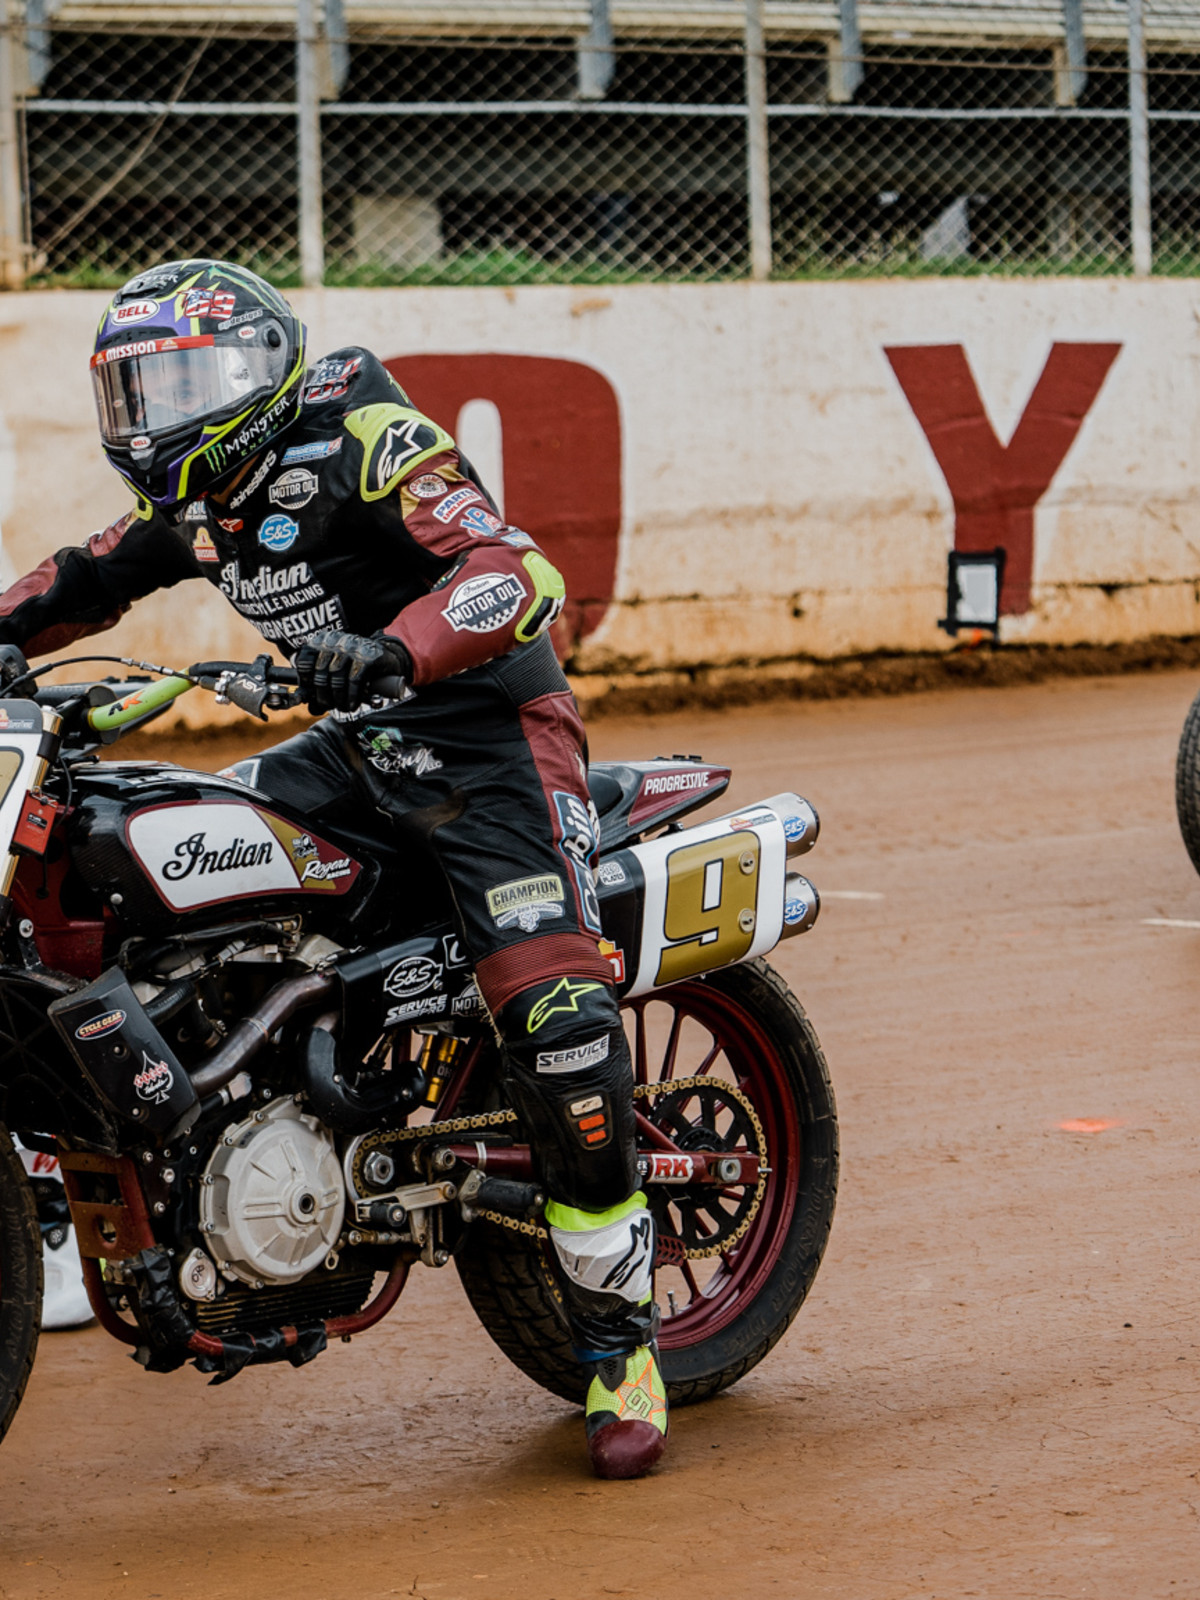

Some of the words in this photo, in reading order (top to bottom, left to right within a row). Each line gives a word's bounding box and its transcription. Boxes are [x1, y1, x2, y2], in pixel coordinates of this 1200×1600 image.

[117, 304, 151, 320] BELL
[224, 396, 290, 455] MONSTER
[241, 417, 285, 456] ENERGY
[230, 450, 278, 510] alpinestars
[271, 482, 301, 499] MOTOR
[302, 480, 316, 493] OIL
[436, 489, 475, 517] PARTS
[264, 523, 292, 542] S&S
[219, 561, 311, 601] Indian
[283, 583, 325, 608] RACING
[449, 591, 498, 625] MOTOR
[495, 582, 521, 601] OIL
[644, 771, 710, 796] PROGRESSIVE
[784, 820, 806, 835] S&S
[161, 833, 274, 881] Indian
[492, 880, 559, 907] CHAMPION
[654, 830, 762, 988] 9
[784, 902, 806, 918] S&S
[391, 963, 433, 990] S&S
[387, 994, 448, 1020] SERVICE
[419, 1004, 447, 1016] PRO
[455, 995, 484, 1012] MOTO
[79, 1020, 102, 1035] CYCLE
[102, 1011, 122, 1026] GEAR
[538, 1037, 608, 1066] SERVICE
[655, 1157, 689, 1177] RK
